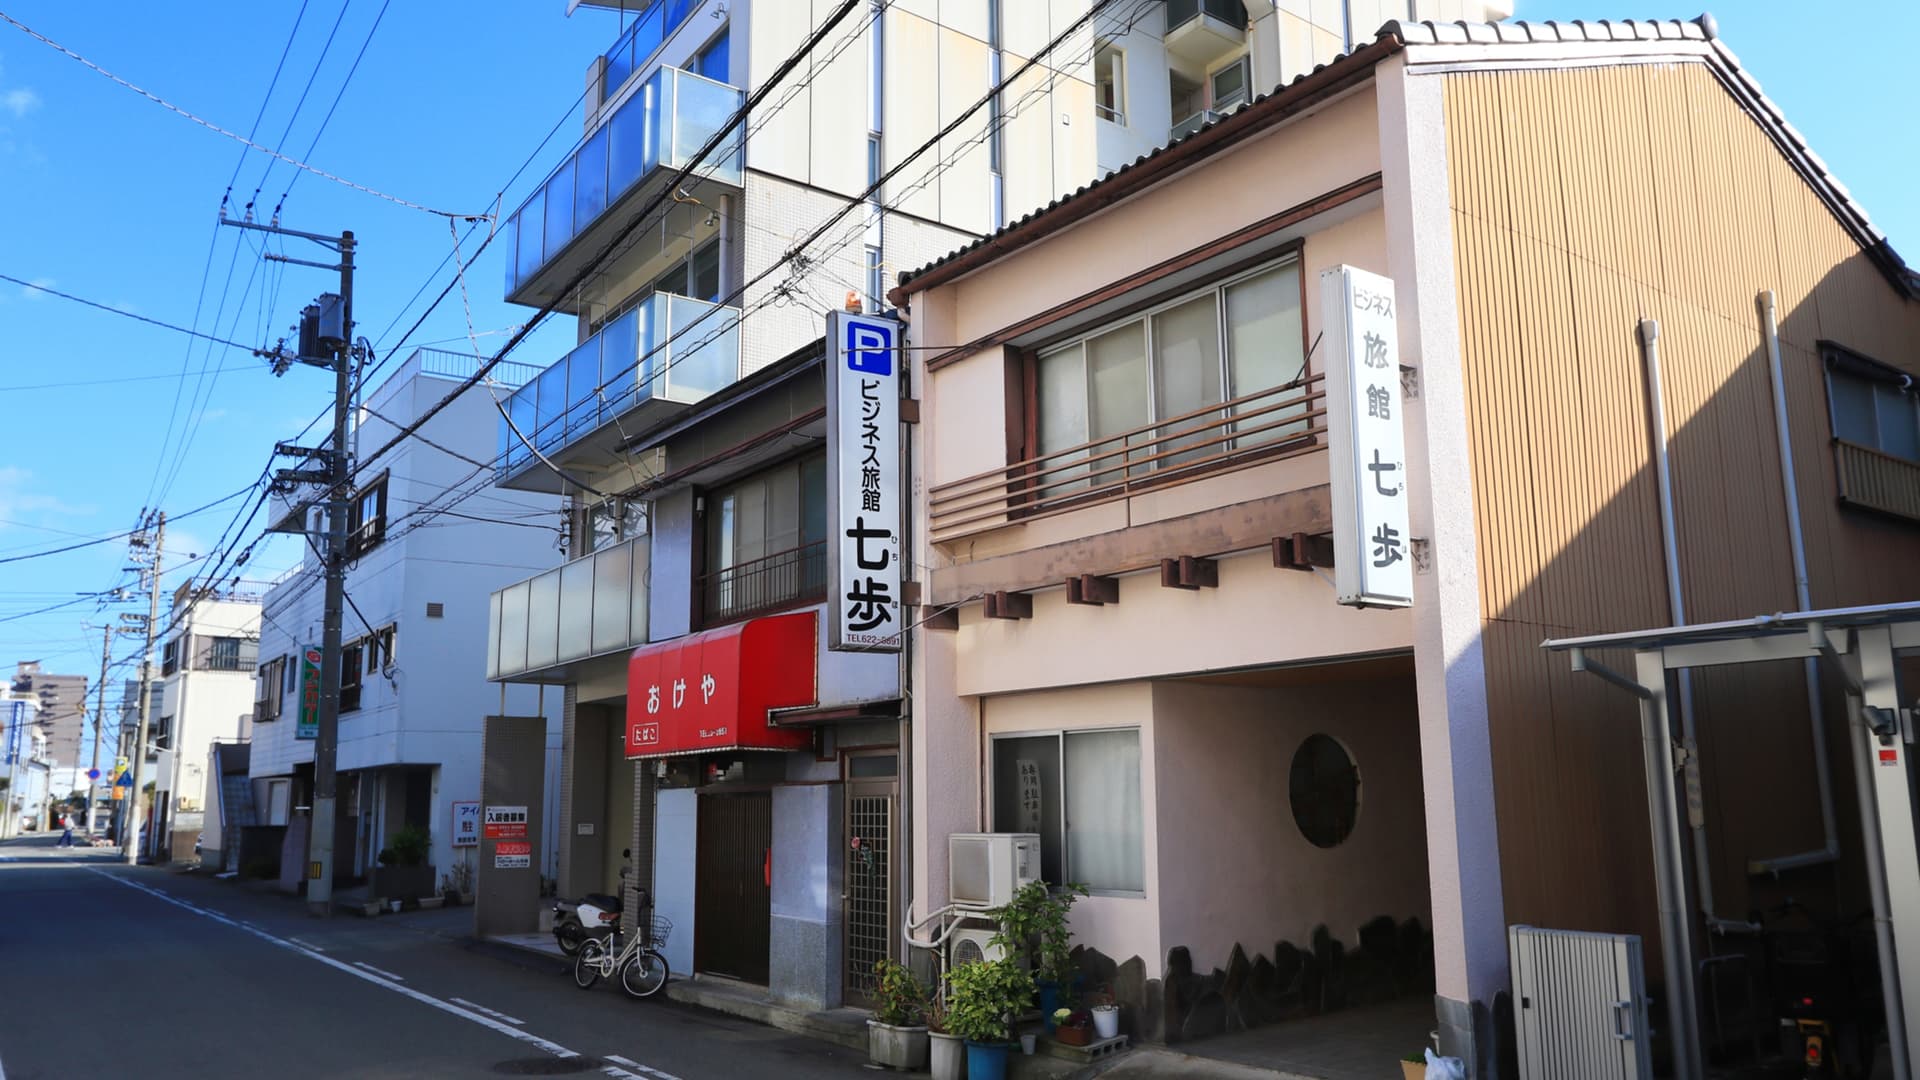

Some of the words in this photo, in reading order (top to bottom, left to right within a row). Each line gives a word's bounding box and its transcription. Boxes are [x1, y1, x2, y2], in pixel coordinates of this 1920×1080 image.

[1353, 285, 1393, 319] ビジネス
[855, 327, 886, 367] P
[861, 379, 881, 513] ビジネス旅館
[1368, 448, 1403, 568] 七歩
[846, 516, 892, 631] 七歩
[647, 673, 716, 714] おけや
[635, 728, 656, 741] たばこ
